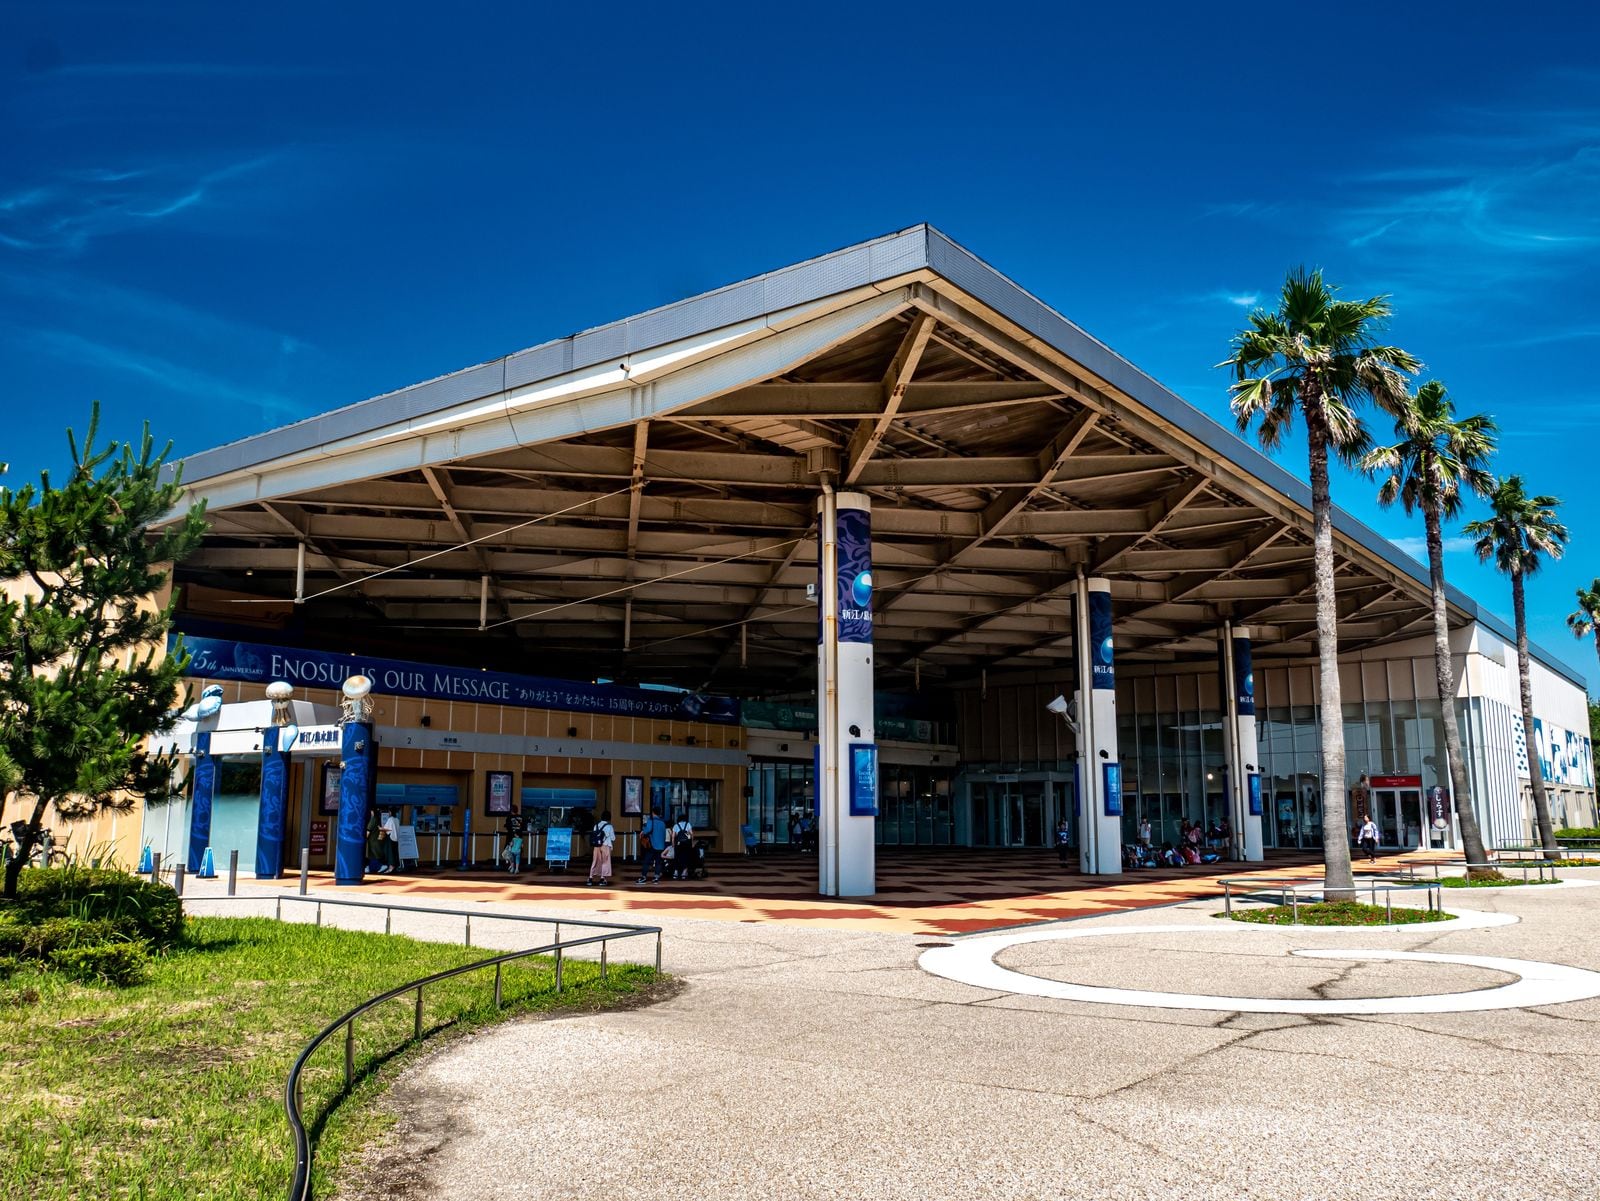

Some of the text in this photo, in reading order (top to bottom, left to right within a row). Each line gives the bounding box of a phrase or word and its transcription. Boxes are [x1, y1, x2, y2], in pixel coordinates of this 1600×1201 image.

[842, 608, 873, 621] 新江ノ島
[220, 665, 264, 675] ANNIVERSARY
[384, 670, 427, 692] OUR
[433, 672, 510, 699] MESSAGE
[407, 737, 412, 745] 2
[534, 744, 539, 752] 3
